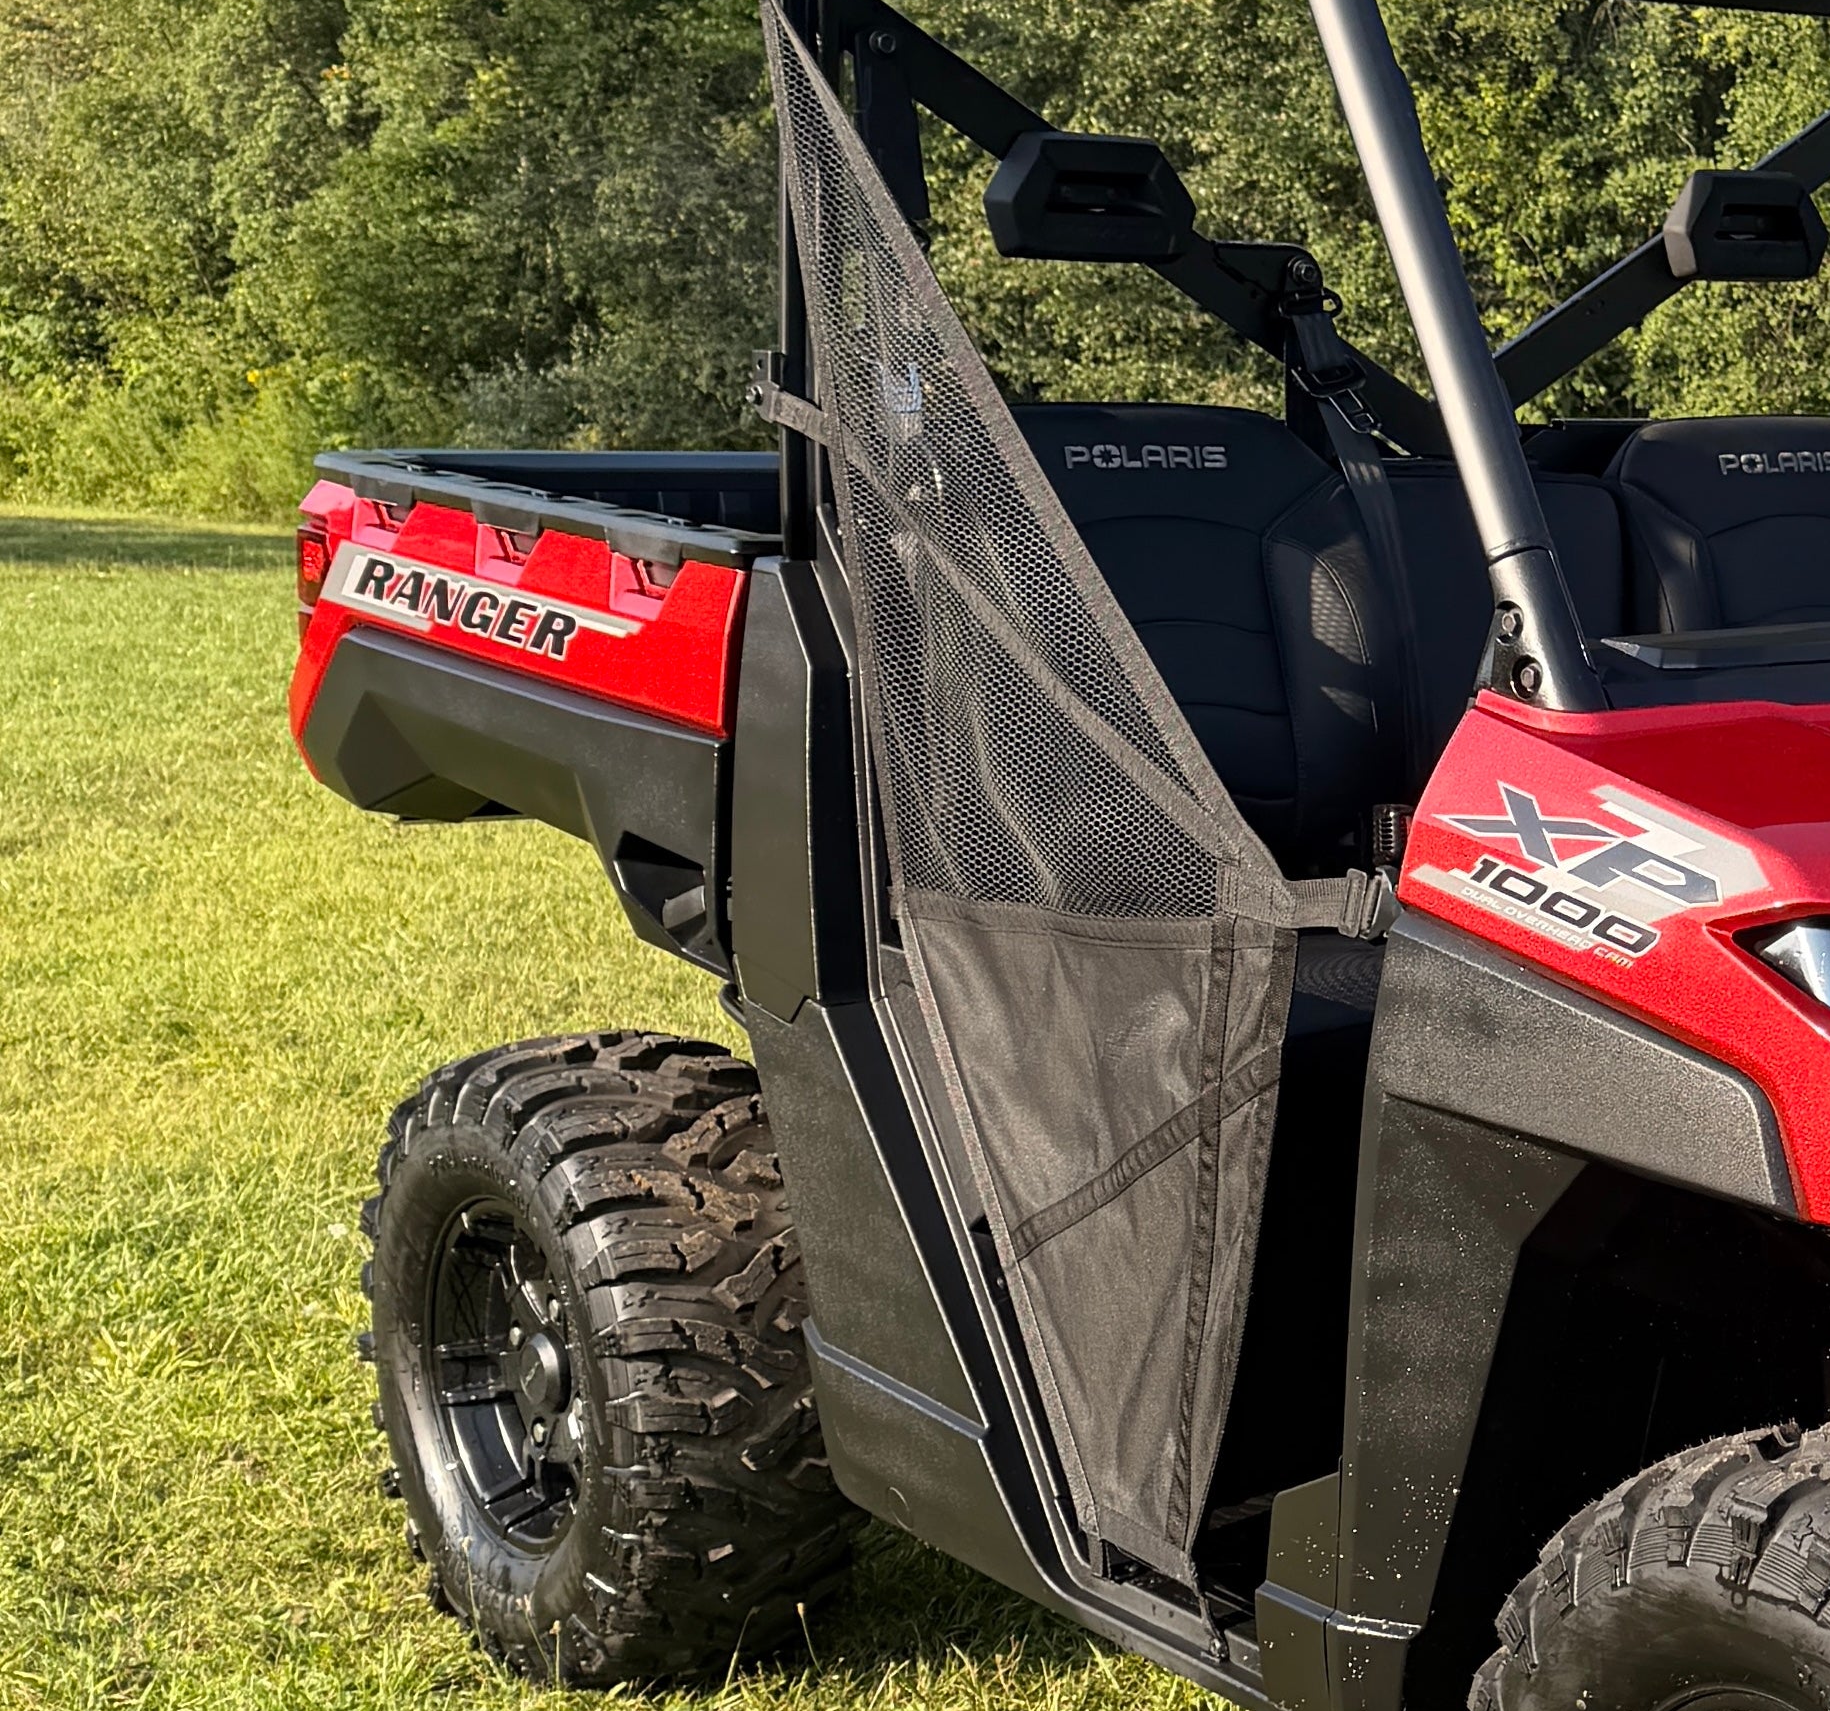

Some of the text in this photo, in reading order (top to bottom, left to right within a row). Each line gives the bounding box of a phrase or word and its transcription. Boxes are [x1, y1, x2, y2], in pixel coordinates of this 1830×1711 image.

[1063, 443, 1228, 470] POLARIS
[354, 555, 579, 661] RANGER
[1430, 779, 1724, 908] XP
[1460, 887, 1636, 970] DUAL OVERHEAD CAM
[1466, 855, 1661, 958] 1000
